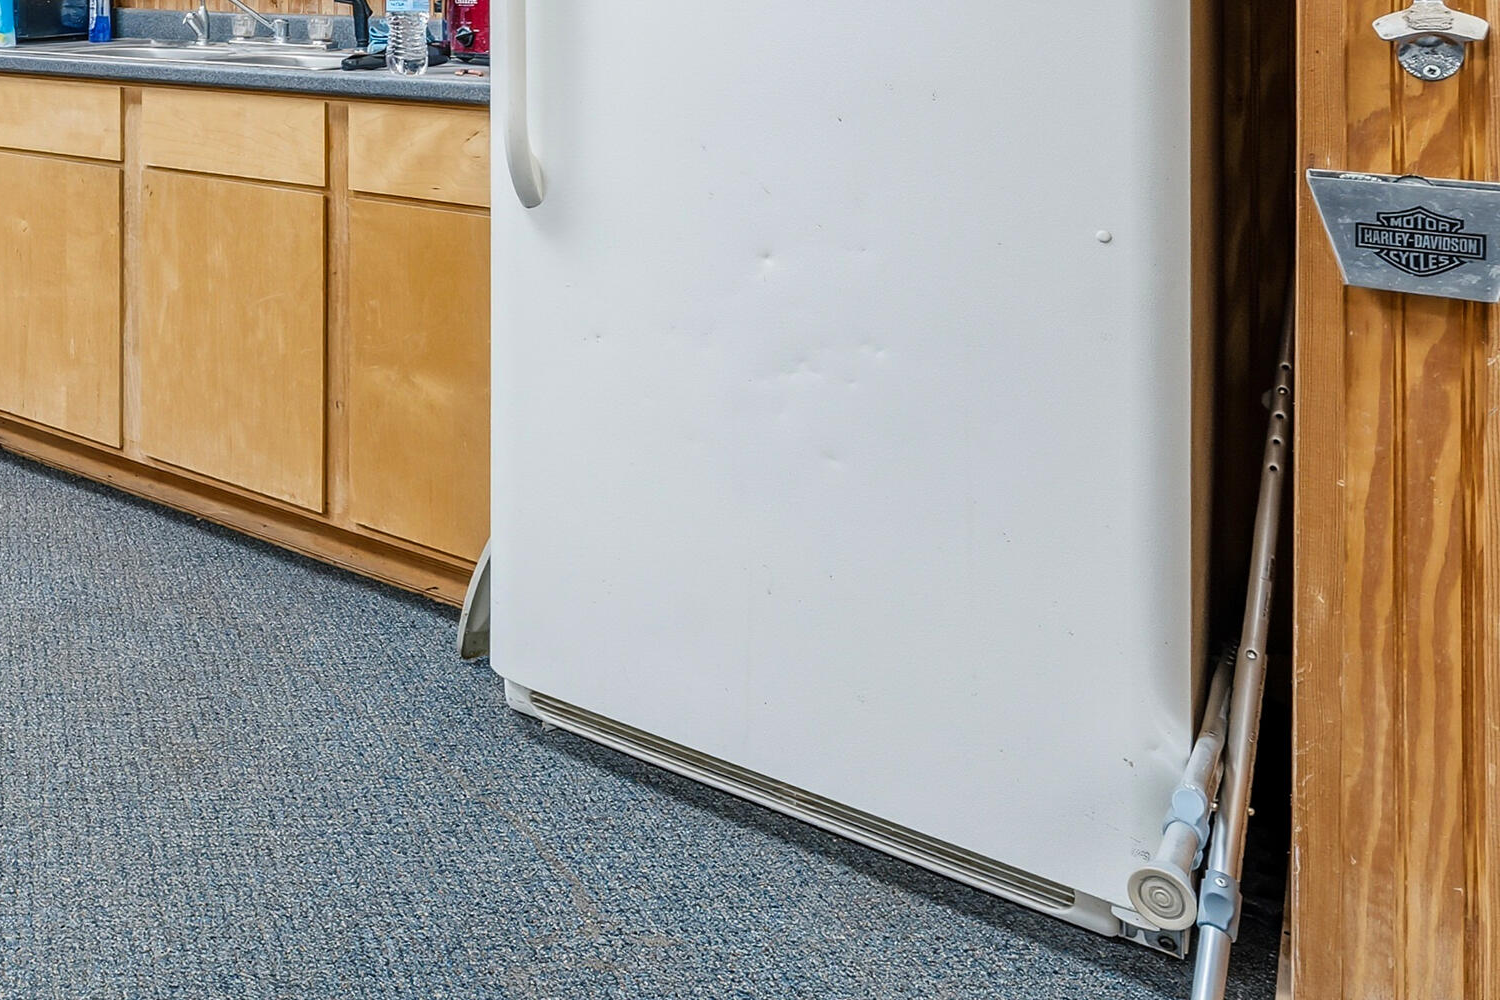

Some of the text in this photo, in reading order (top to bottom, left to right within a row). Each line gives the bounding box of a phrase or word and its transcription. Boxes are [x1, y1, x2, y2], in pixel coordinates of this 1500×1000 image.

[1390, 213, 1450, 232] MOTOR
[1363, 228, 1478, 254] HARLEY-DAVIDSON
[1389, 250, 1450, 271] CYCLES
